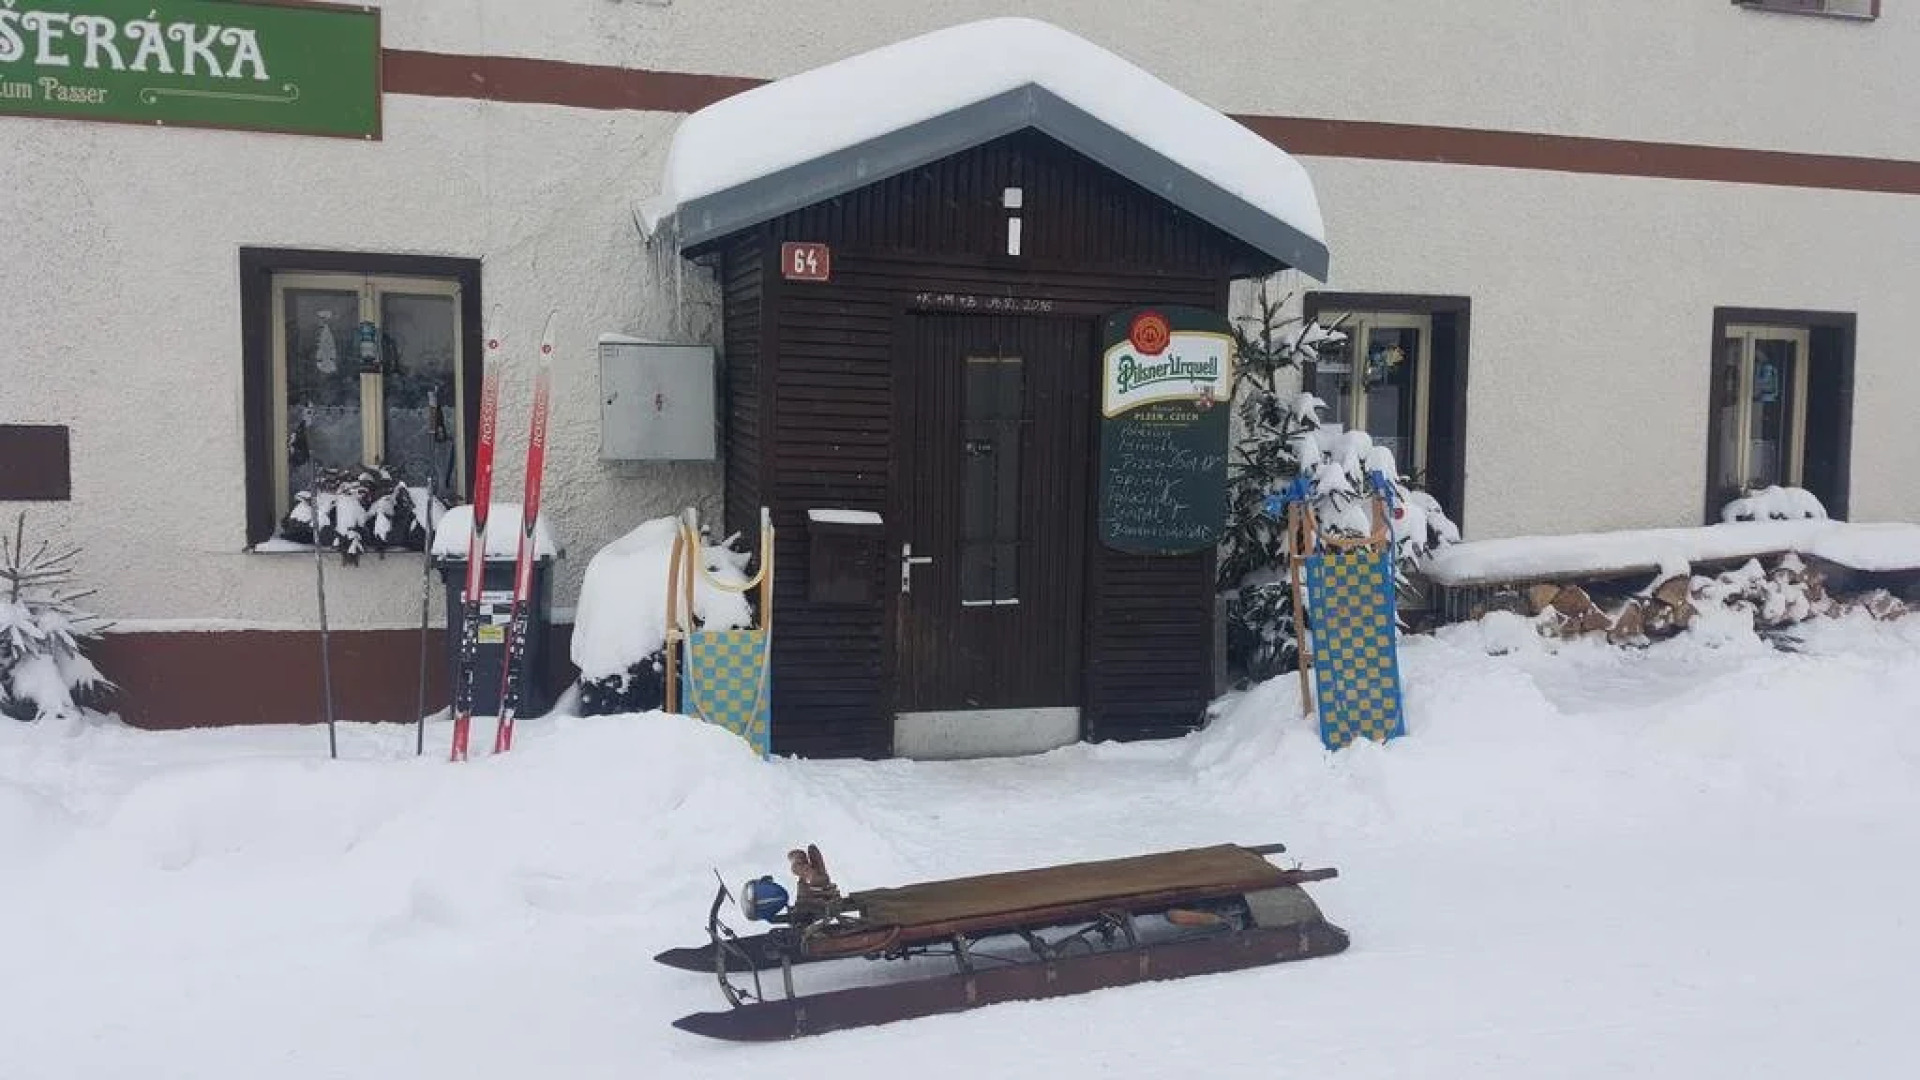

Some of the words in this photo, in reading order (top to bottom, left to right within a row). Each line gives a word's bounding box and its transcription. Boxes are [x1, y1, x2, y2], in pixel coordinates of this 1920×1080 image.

[0, 75, 33, 99] um
[39, 76, 107, 103] Passer
[794, 248, 818, 274] 64
[1117, 354, 1170, 394] Pilsner
[1168, 353, 1218, 383] Urquell
